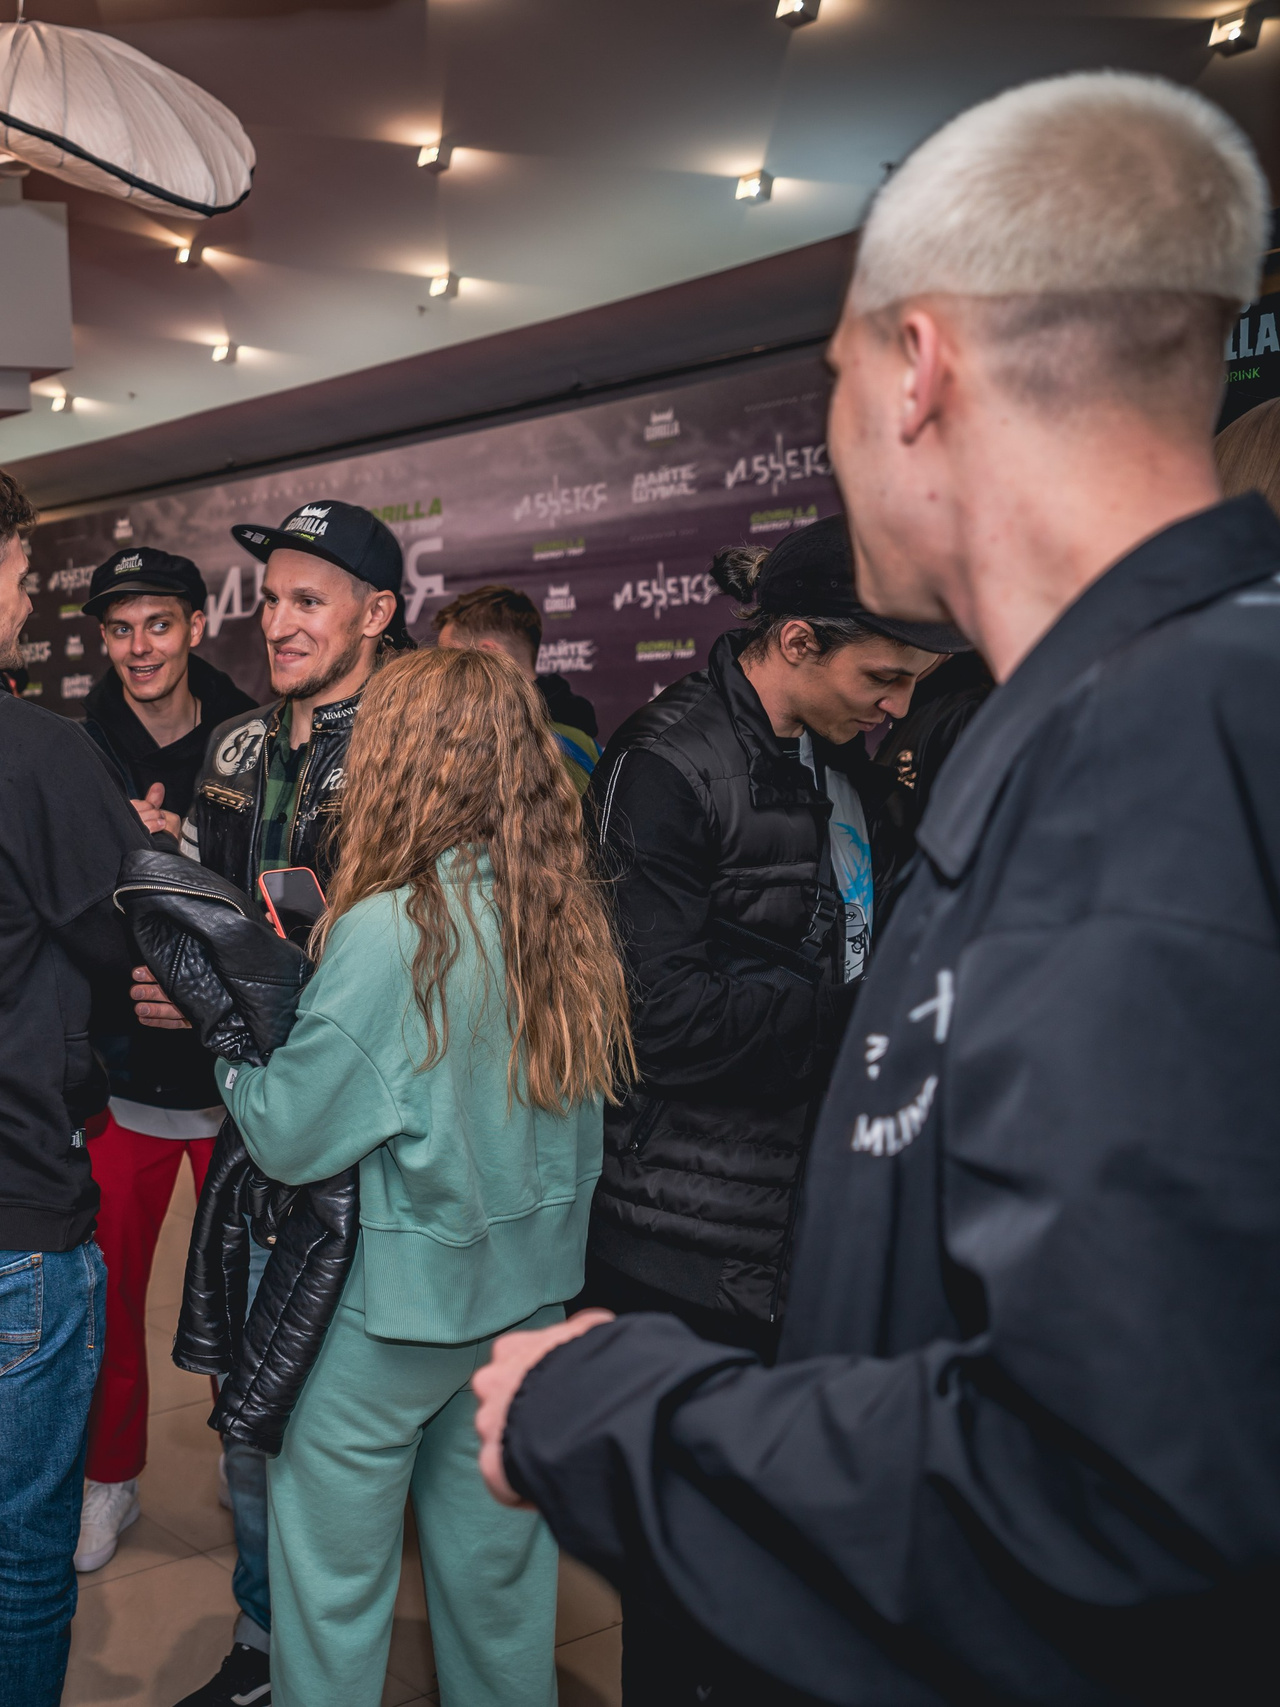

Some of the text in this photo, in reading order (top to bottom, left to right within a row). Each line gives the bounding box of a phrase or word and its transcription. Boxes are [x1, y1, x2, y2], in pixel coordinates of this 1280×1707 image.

[284, 516, 329, 537] GORILLA
[114, 558, 143, 573] GORILLA
[636, 638, 695, 652] GORILLA
[321, 707, 354, 721] ARMANI
